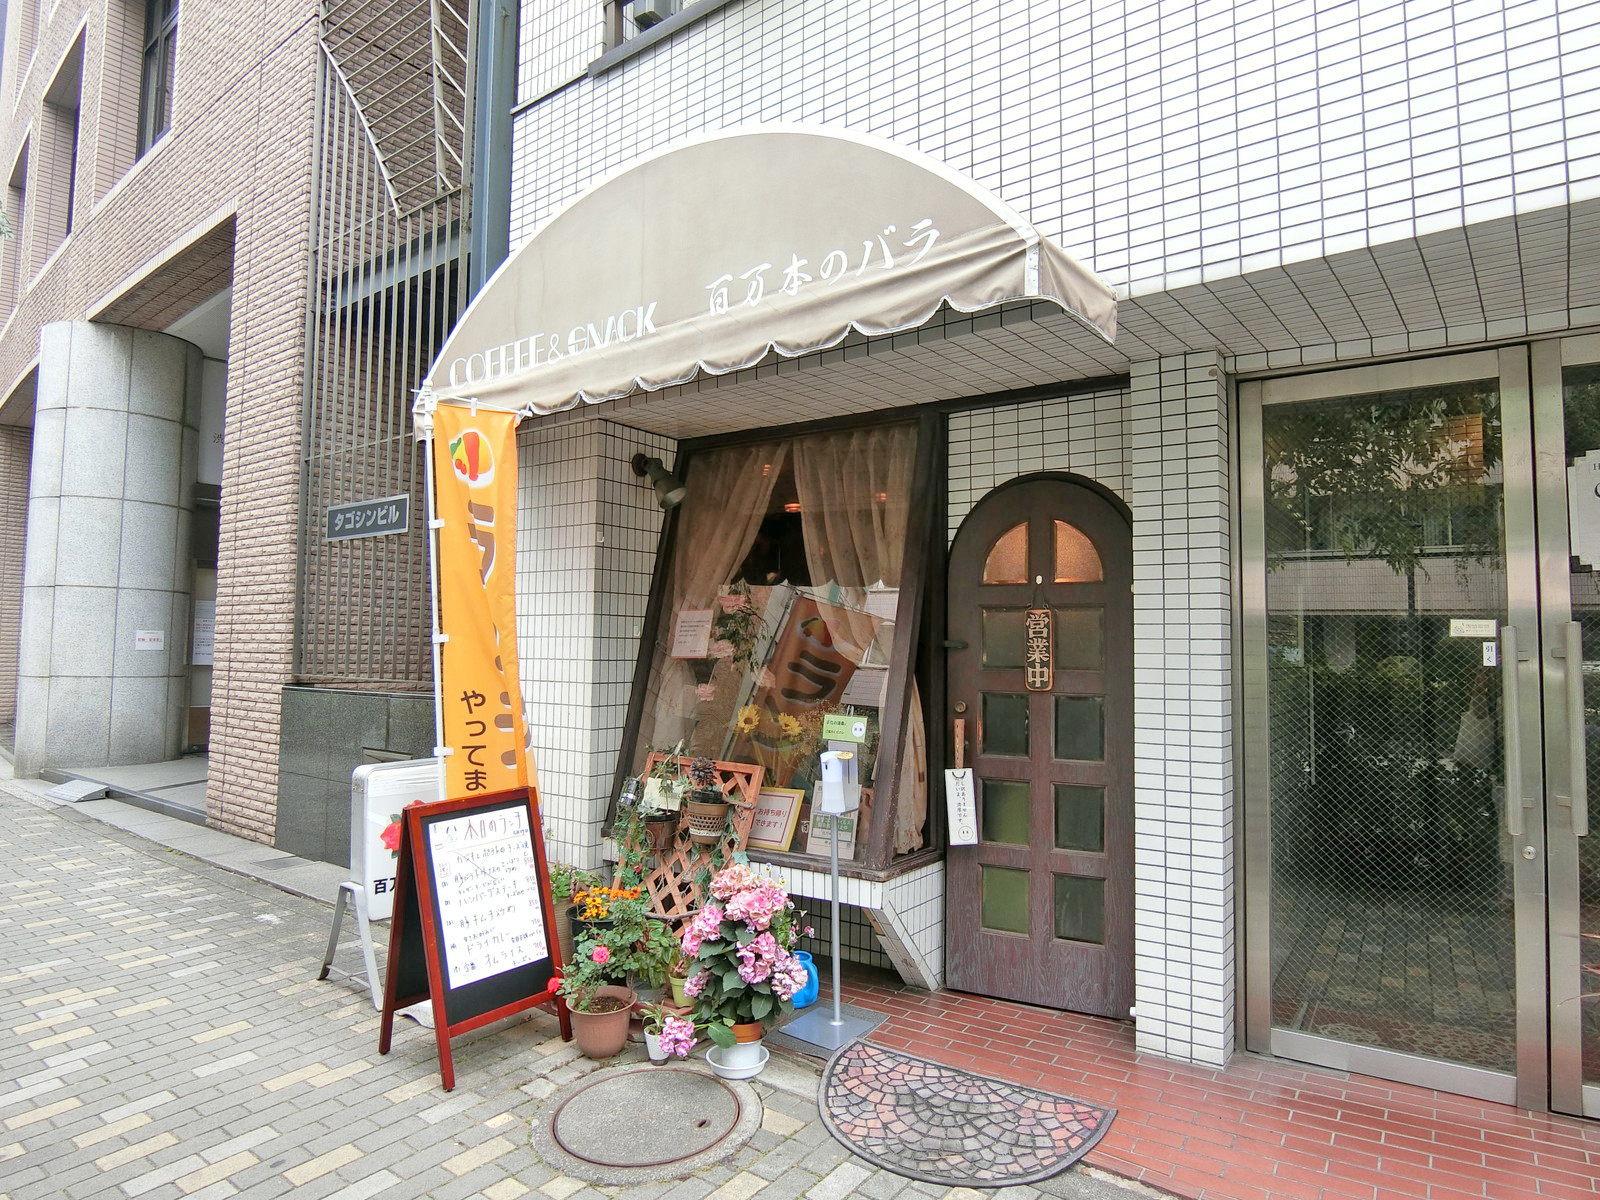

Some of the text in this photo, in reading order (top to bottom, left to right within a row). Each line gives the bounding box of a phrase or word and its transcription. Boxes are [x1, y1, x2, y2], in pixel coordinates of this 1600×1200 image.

[705, 218, 942, 318] 百万本のバラ
[448, 301, 659, 391] COFFEE & SNACK
[334, 505, 399, 531] タゴシンビル
[1025, 613, 1050, 688] 営業中
[1485, 645, 1493, 663] 引く
[460, 690, 487, 792] やってま
[758, 808, 787, 818] お持ち帰り
